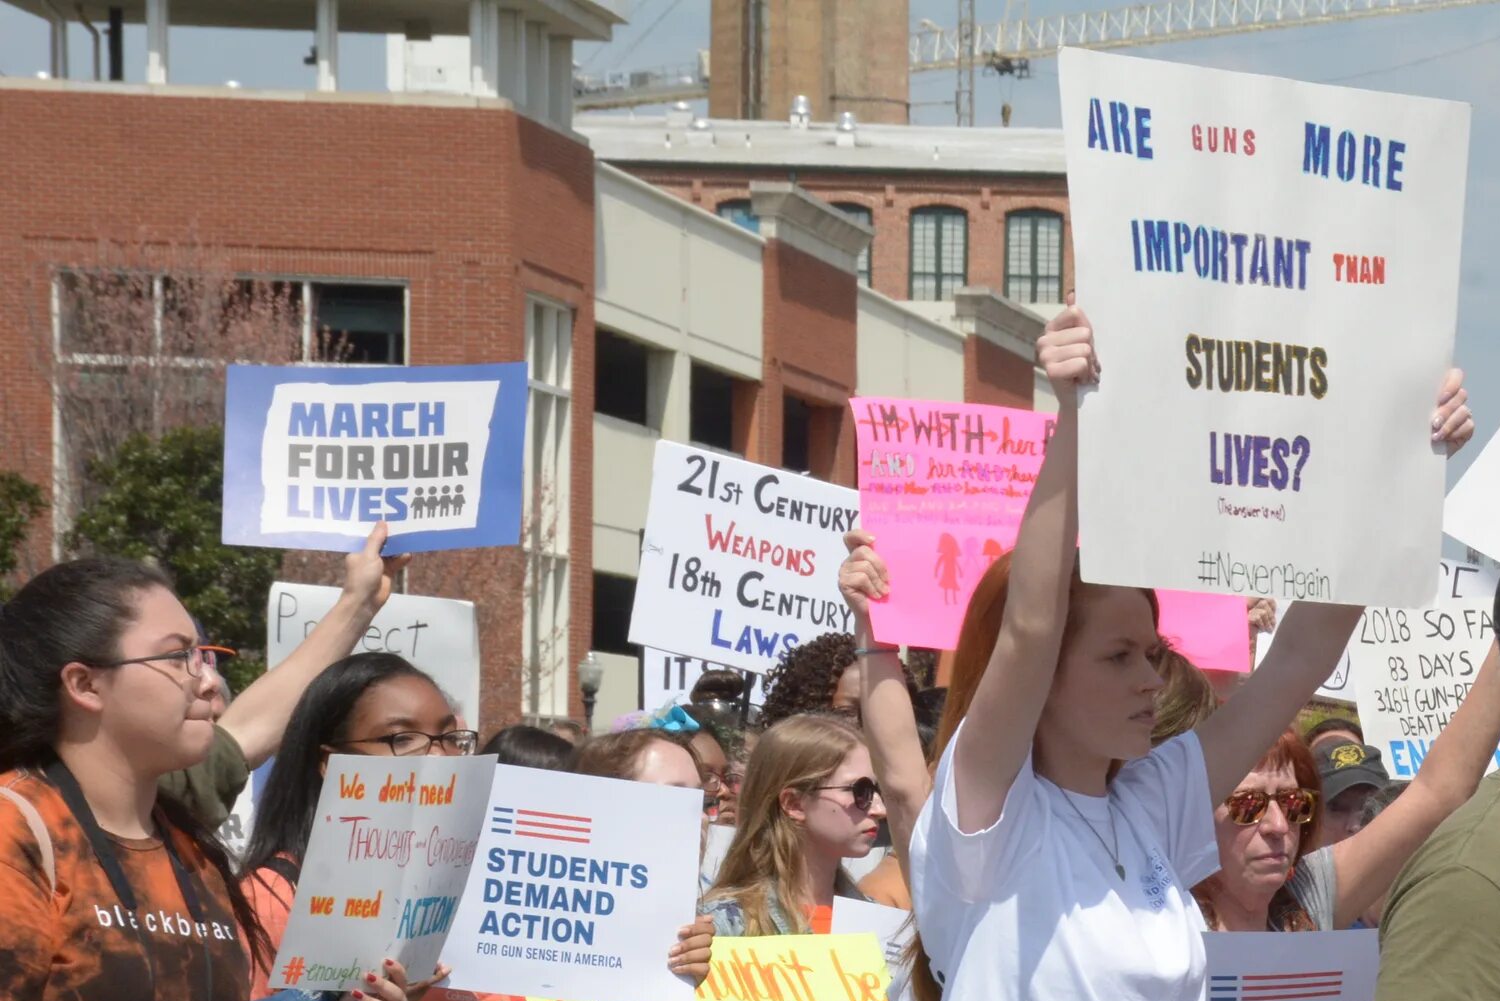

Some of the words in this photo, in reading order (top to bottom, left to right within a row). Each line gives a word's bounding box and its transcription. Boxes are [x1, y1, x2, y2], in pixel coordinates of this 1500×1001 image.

[1087, 97, 1154, 160] ARE
[1191, 123, 1256, 156] GUNS
[1302, 121, 1406, 192] MORE
[1130, 218, 1312, 291] IMPORTANT
[1332, 252, 1386, 285] THAN
[1185, 333, 1329, 400] STUDENTS
[288, 401, 446, 438] MARCH
[909, 406, 985, 455] WITH
[288, 442, 375, 479] FOR
[383, 441, 469, 479] OUR
[677, 454, 743, 506] 21st
[1209, 431, 1311, 493] LIVES?
[286, 485, 409, 523] LIVES
[704, 513, 816, 577] WEAPONS
[667, 552, 722, 599] 18th
[1198, 552, 1331, 600] #NeverAgain
[1360, 607, 1412, 645] 2018
[1423, 609, 1456, 641] SO
[1388, 656, 1409, 682] 83
[1418, 650, 1474, 680] DAYS
[339, 773, 365, 801] We
[378, 772, 416, 804] don't
[418, 773, 456, 806] need
[486, 847, 649, 890] STUDENTS
[310, 896, 335, 915] we
[344, 889, 383, 918] need
[396, 895, 458, 939] ACTION
[483, 878, 616, 916] DEMAND
[478, 910, 595, 946] ACTION
[282, 956, 361, 989] #enough
[476, 942, 498, 956] FOR
[501, 944, 523, 959] GUN
[525, 947, 559, 963] SENSE
[560, 951, 572, 964] IN
[574, 952, 623, 970] AMERICA
